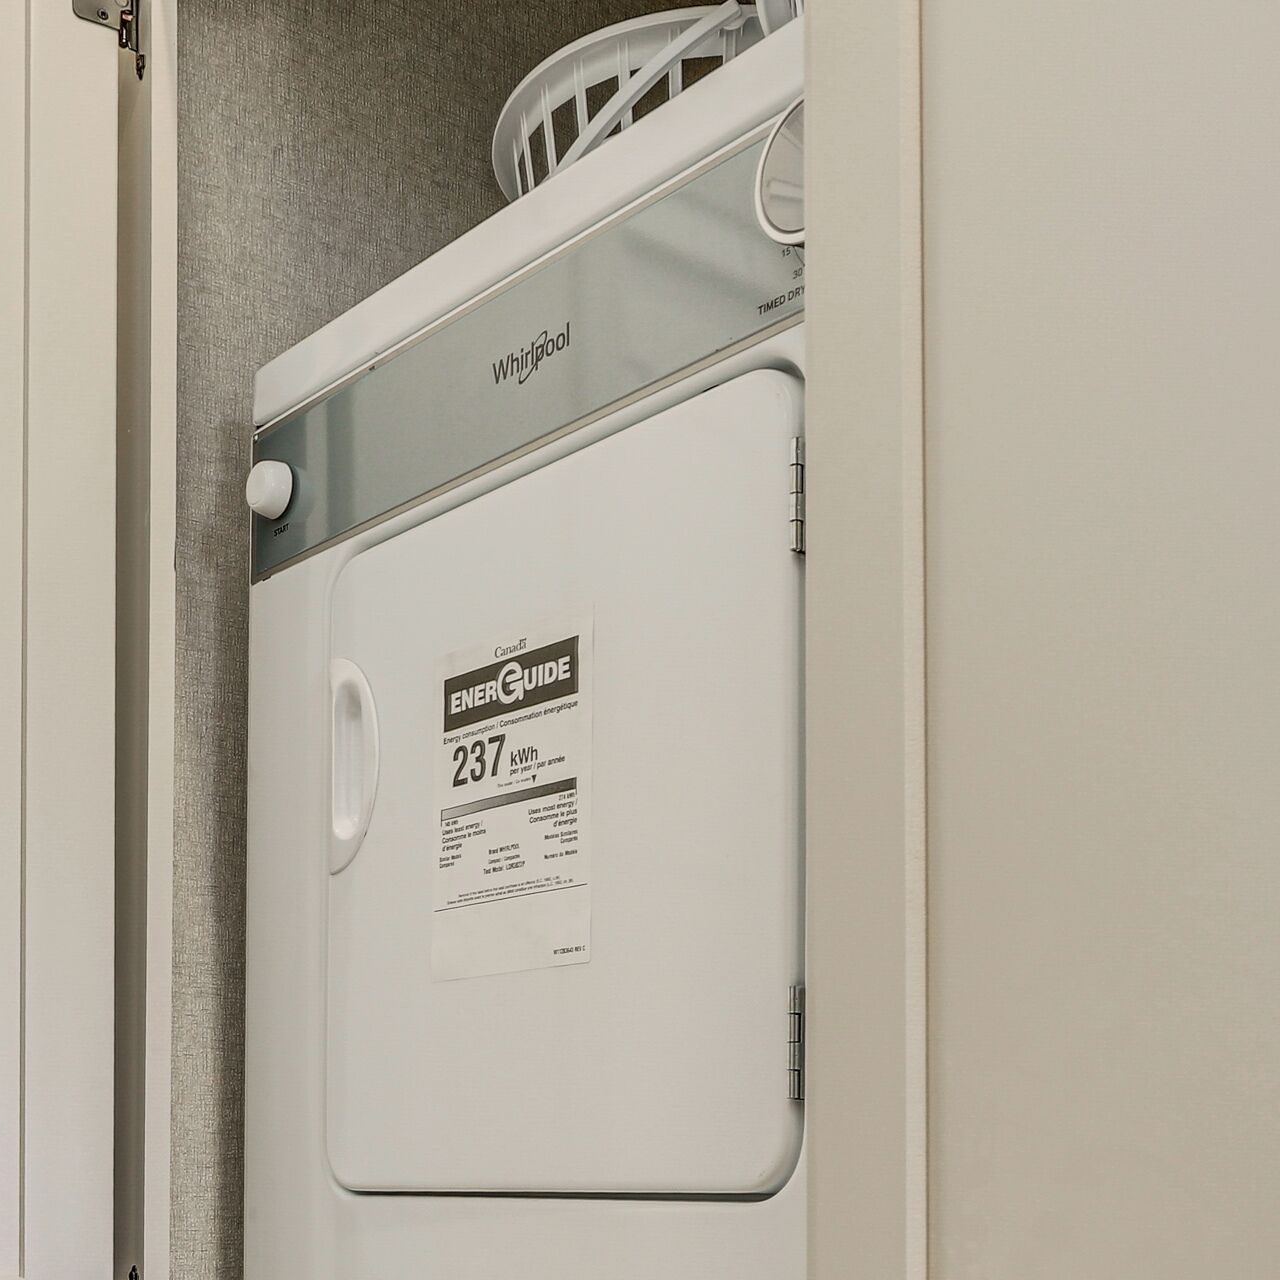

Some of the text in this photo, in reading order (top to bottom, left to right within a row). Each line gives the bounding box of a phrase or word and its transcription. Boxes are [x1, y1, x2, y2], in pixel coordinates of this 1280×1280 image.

[782, 247, 791, 257] 15
[793, 268, 803, 280] 30
[758, 294, 786, 315] TIMED
[493, 321, 570, 385] Whirlpool
[273, 523, 289, 537] START
[494, 638, 527, 658] Canada
[450, 655, 571, 715] ENERGUIDE
[443, 735, 461, 745] Energy
[462, 723, 496, 739] consumption
[500, 709, 542, 728] Consommation
[543, 700, 579, 716] énergétique
[452, 733, 506, 787] 237
[510, 746, 538, 767] kWh
[510, 767, 519, 776] per
[520, 763, 532, 774] year
[537, 760, 547, 770] par
[529, 813, 559, 824] Consomme
[566, 809, 578, 817] plus
[542, 804, 556, 812] most
[556, 801, 574, 809] energy
